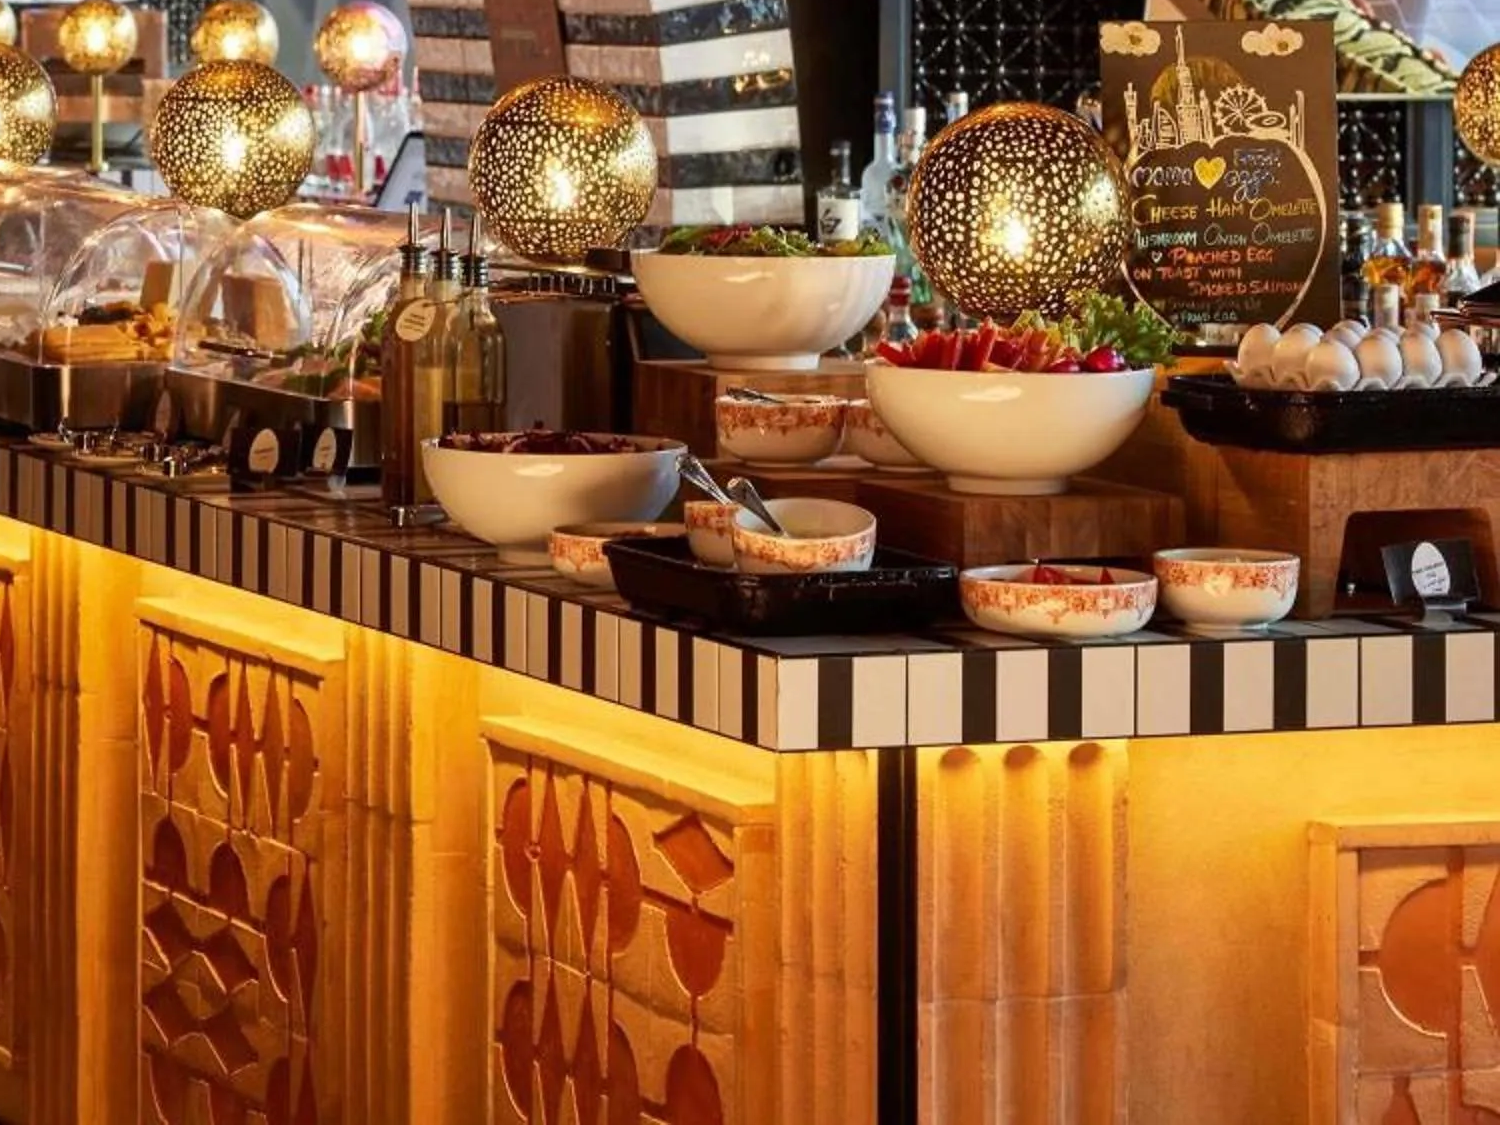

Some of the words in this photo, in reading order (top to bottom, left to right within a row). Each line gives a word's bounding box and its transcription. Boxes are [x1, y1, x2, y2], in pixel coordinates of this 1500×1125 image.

[1205, 197, 1244, 219] HAM
[1246, 246, 1274, 264] EGG
[1133, 268, 1152, 280] ON
